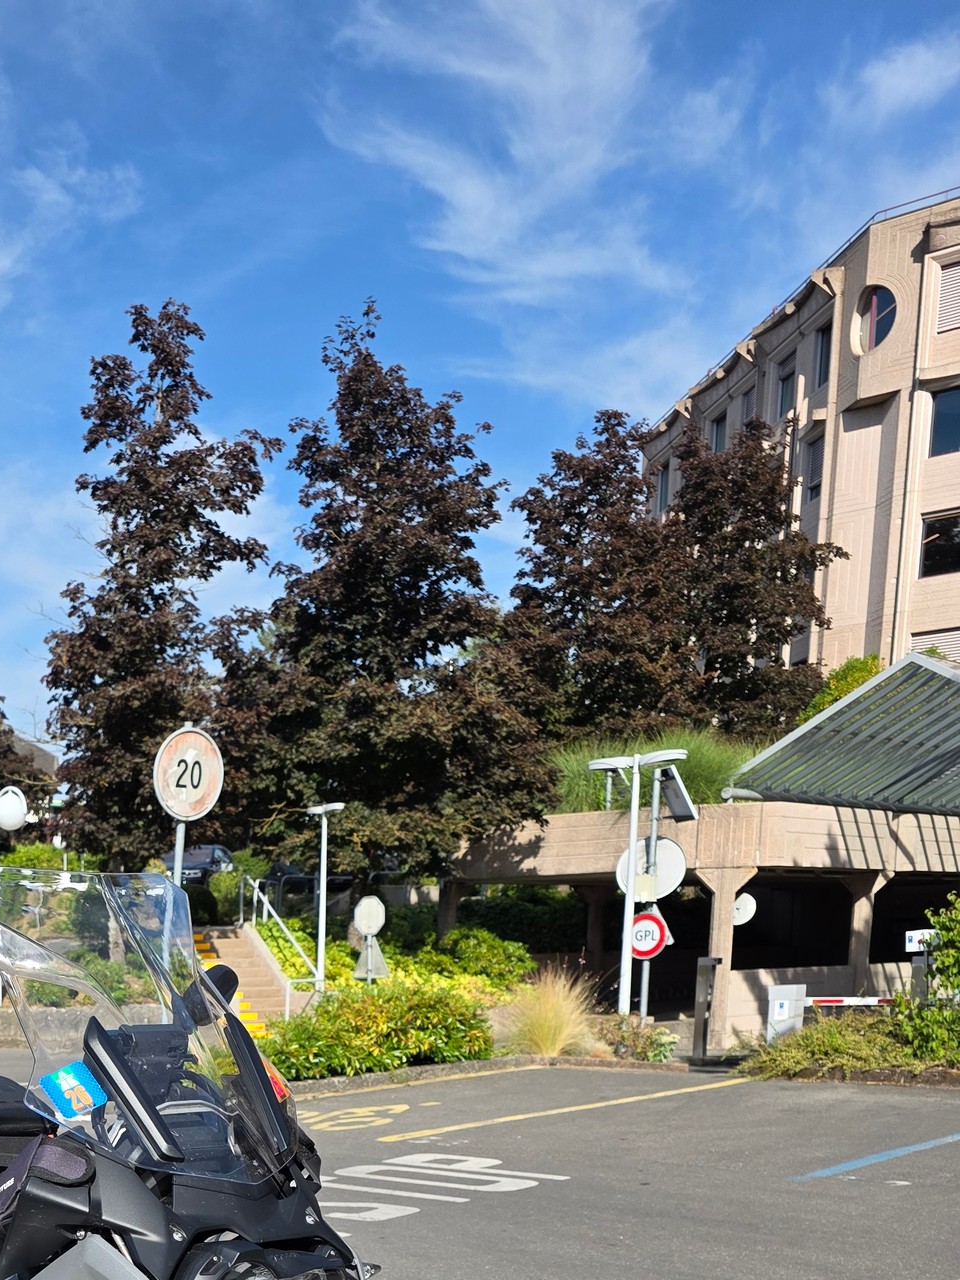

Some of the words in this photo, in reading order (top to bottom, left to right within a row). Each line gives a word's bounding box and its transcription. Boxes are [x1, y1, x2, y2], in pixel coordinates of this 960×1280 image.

[175, 758, 202, 790] 20
[634, 929, 657, 942] GPL
[64, 1084, 94, 1112] 26
